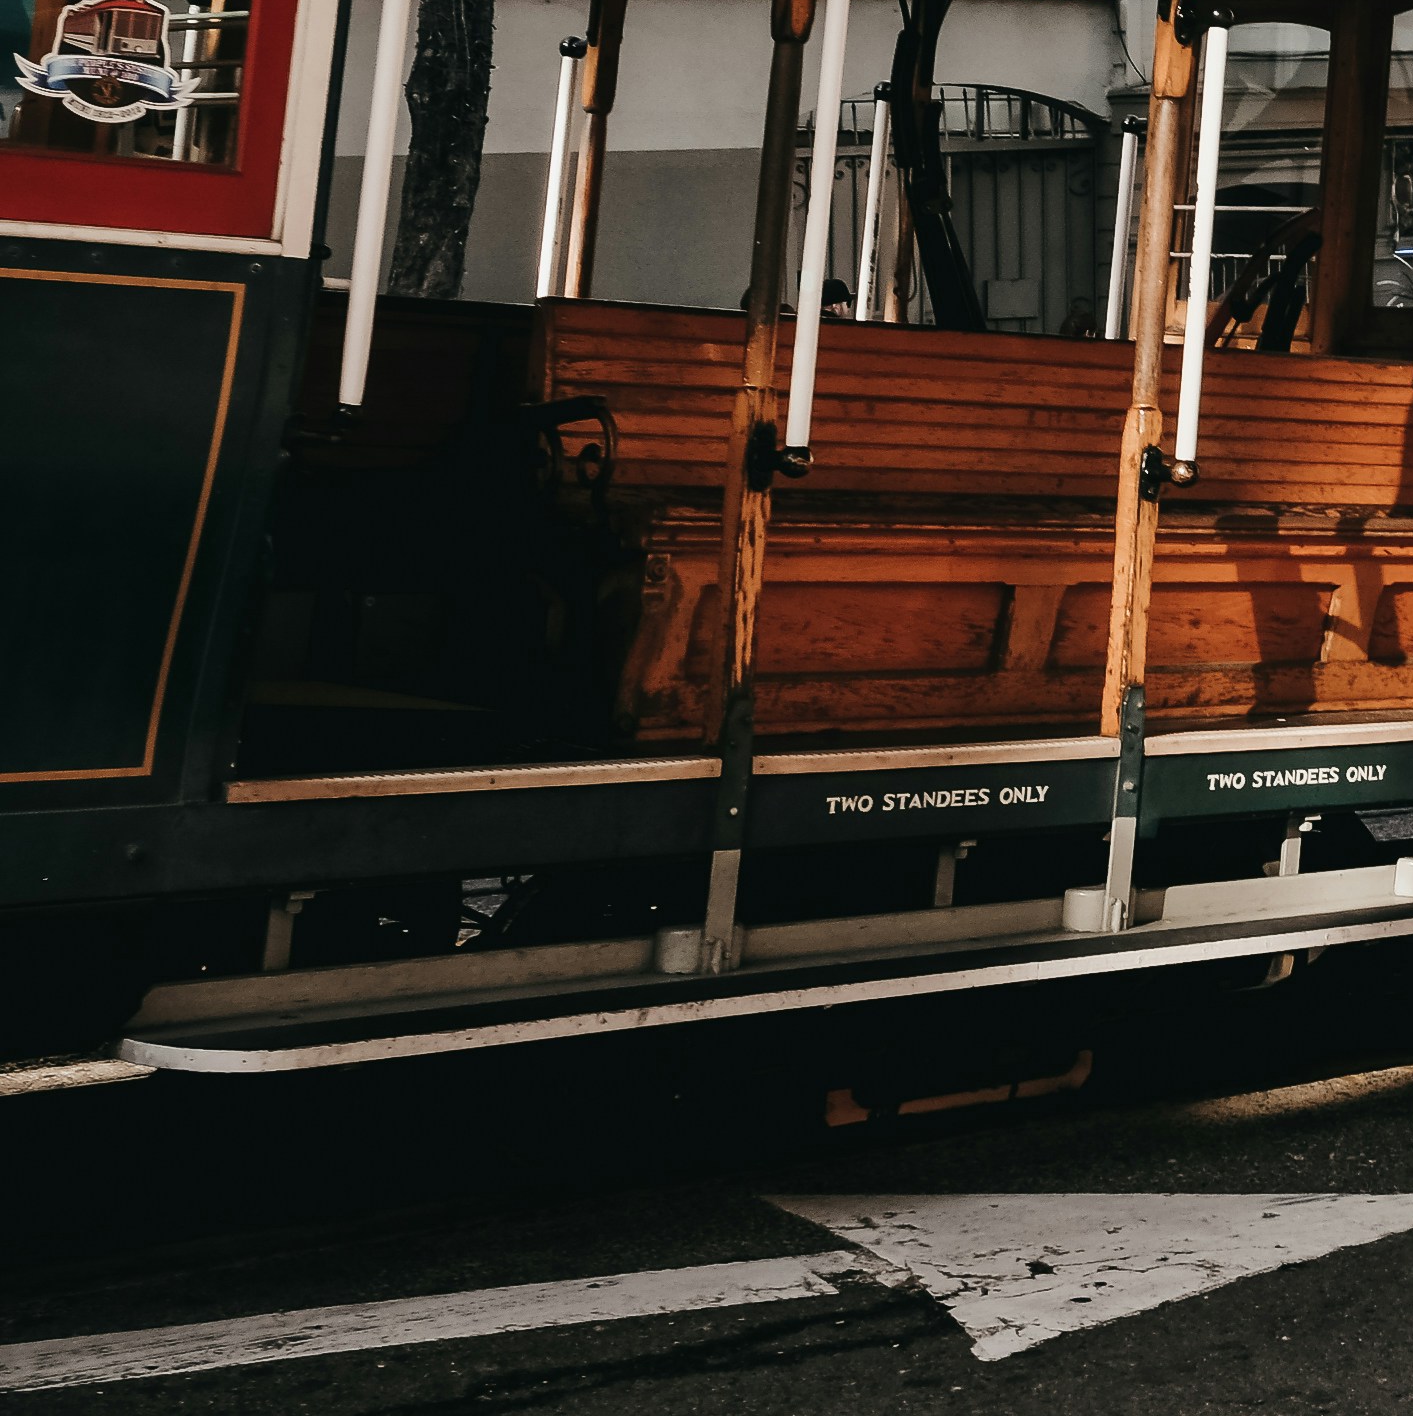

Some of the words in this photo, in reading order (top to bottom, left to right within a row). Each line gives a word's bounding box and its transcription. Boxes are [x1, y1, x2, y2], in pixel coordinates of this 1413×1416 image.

[1207, 772, 1247, 791] TWO
[1251, 766, 1340, 789] STANDEES
[1346, 764, 1388, 784] ONLY
[826, 795, 874, 815] TWO
[882, 787, 991, 811] STANDEES
[999, 785, 1050, 805] ONLY
